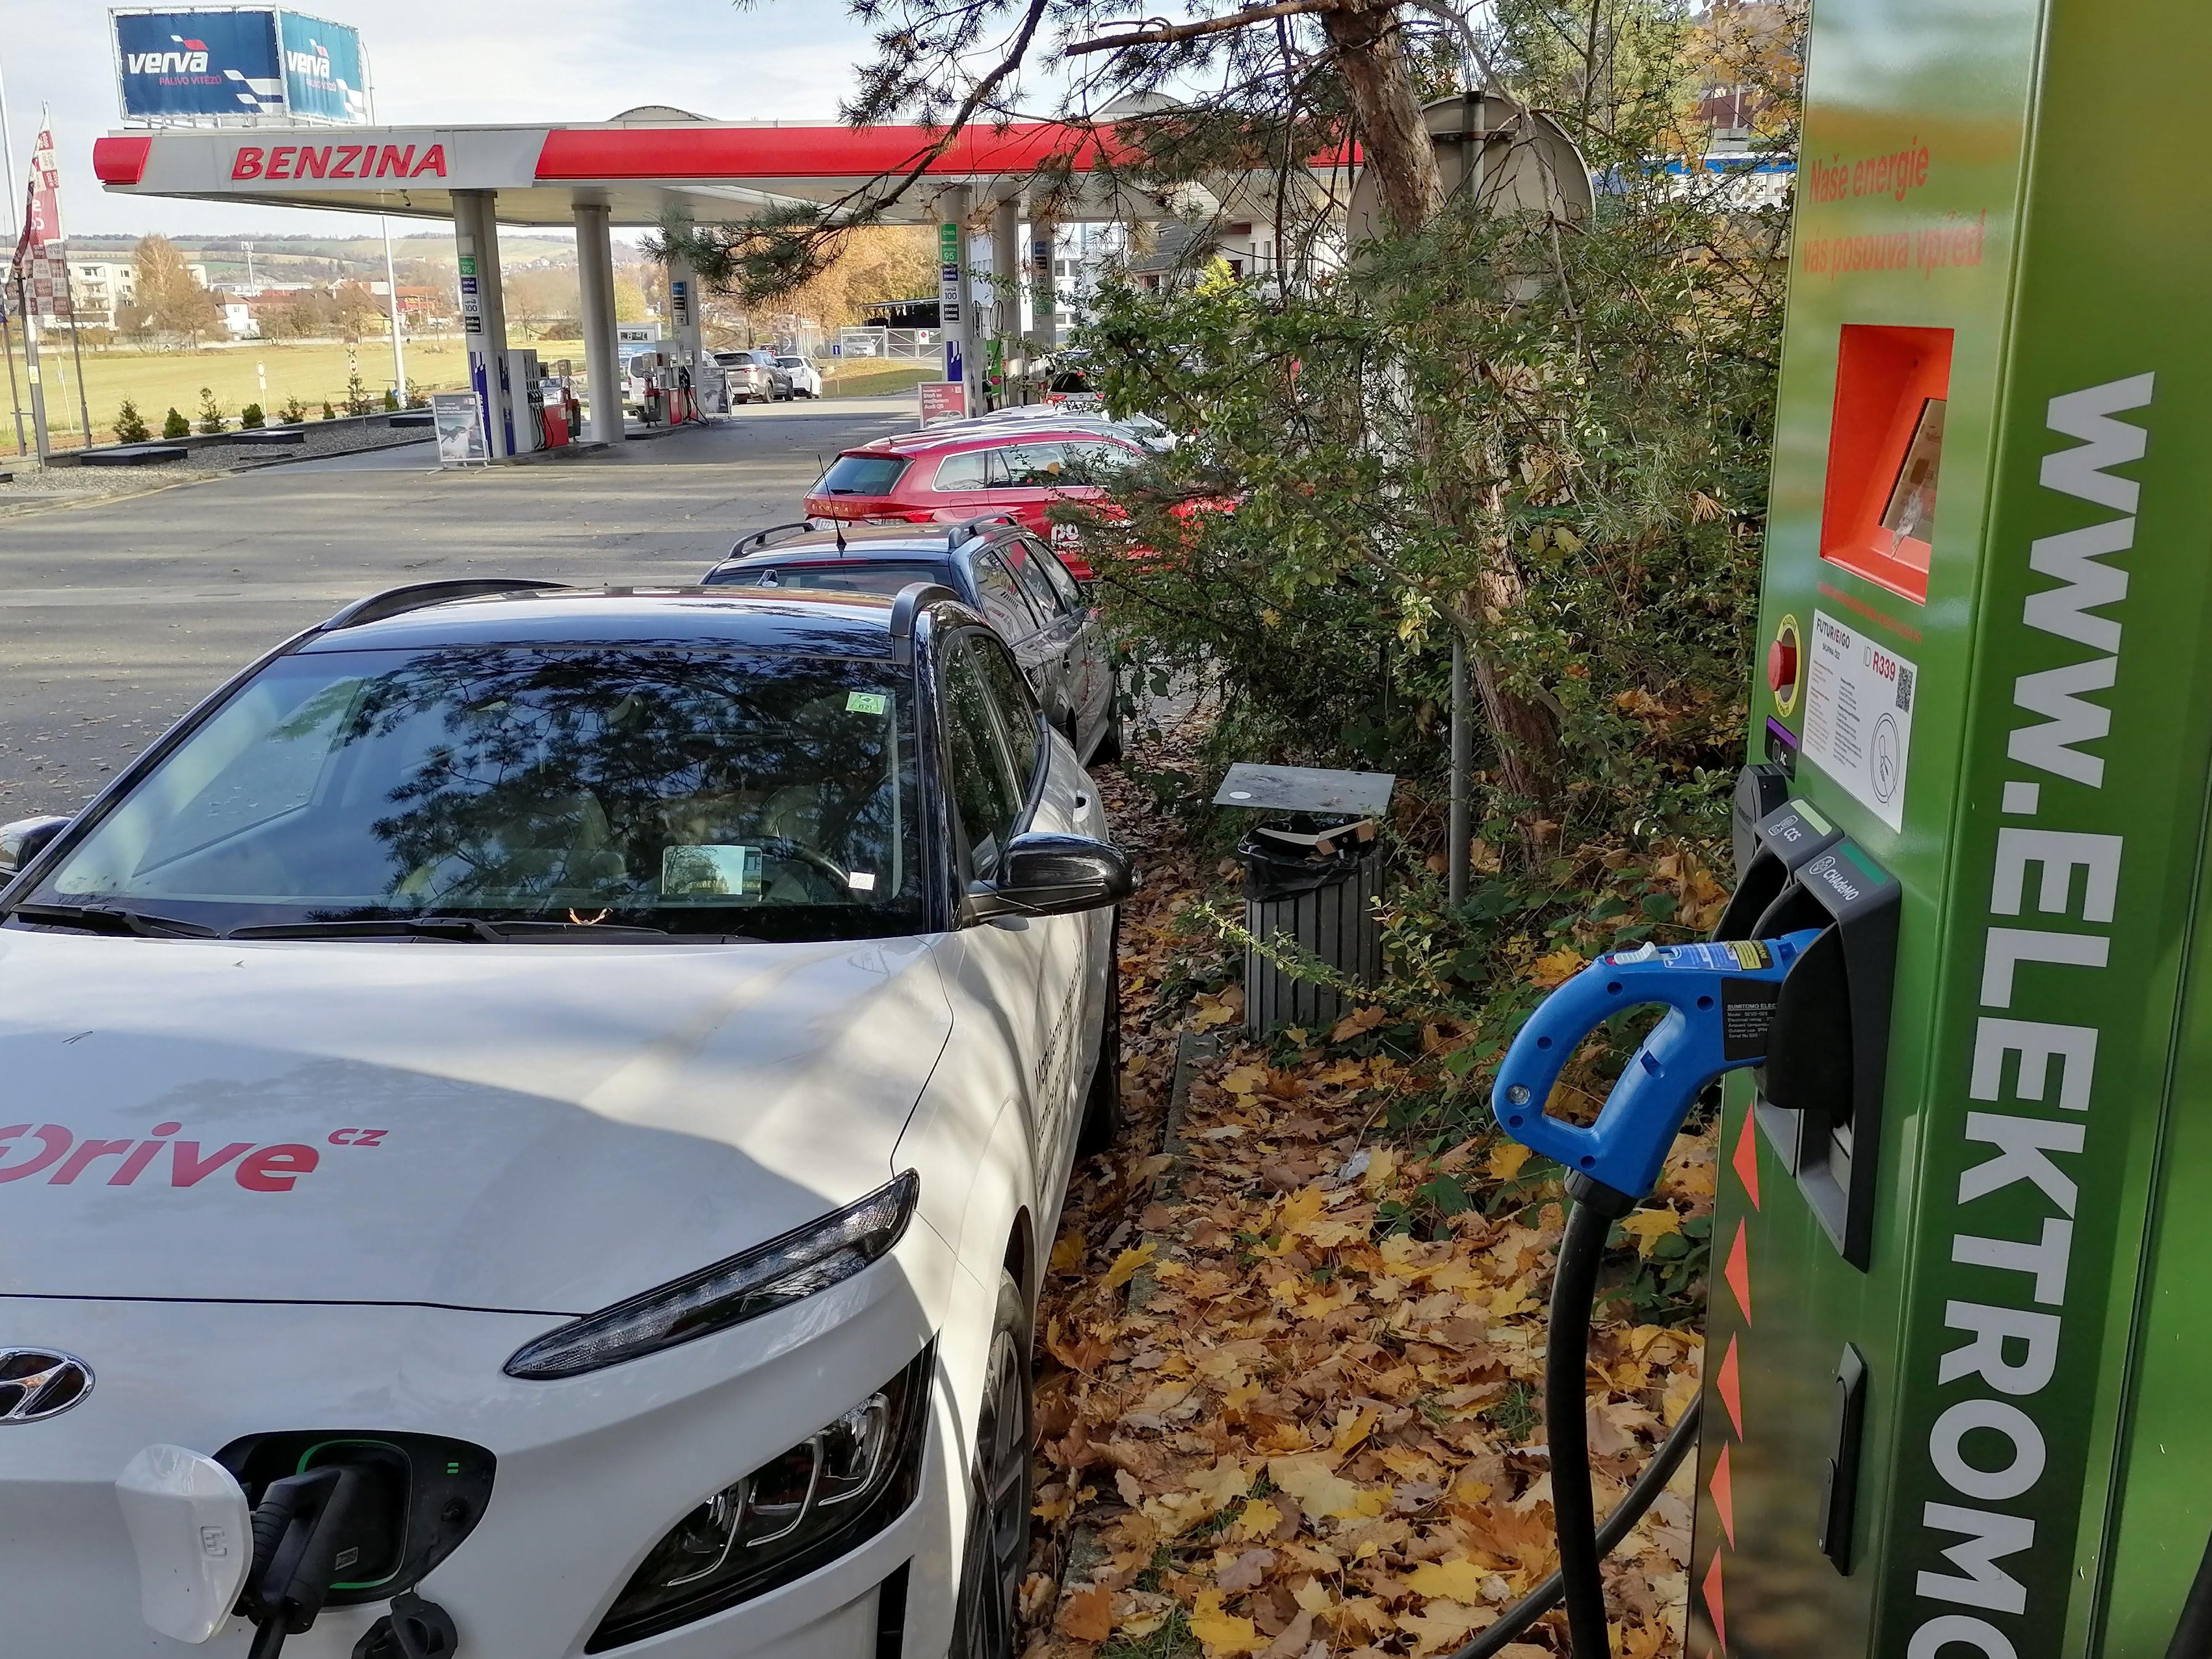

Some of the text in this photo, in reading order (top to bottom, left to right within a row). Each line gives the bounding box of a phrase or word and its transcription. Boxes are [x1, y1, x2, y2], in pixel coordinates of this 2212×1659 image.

[128, 51, 208, 74] verva
[286, 50, 331, 79] verva
[159, 77, 189, 86] PALIVO
[232, 144, 447, 180] BENZINA
[1809, 135, 1929, 204] Naše energie
[944, 252, 955, 260] 95
[462, 265, 473, 274] 95
[945, 292, 957, 300] 100
[1863, 645, 1896, 682] ID R339
[1780, 750, 1788, 766] AC
[1783, 827, 1802, 842] CCS
[1823, 869, 1860, 901] CHAdeMO
